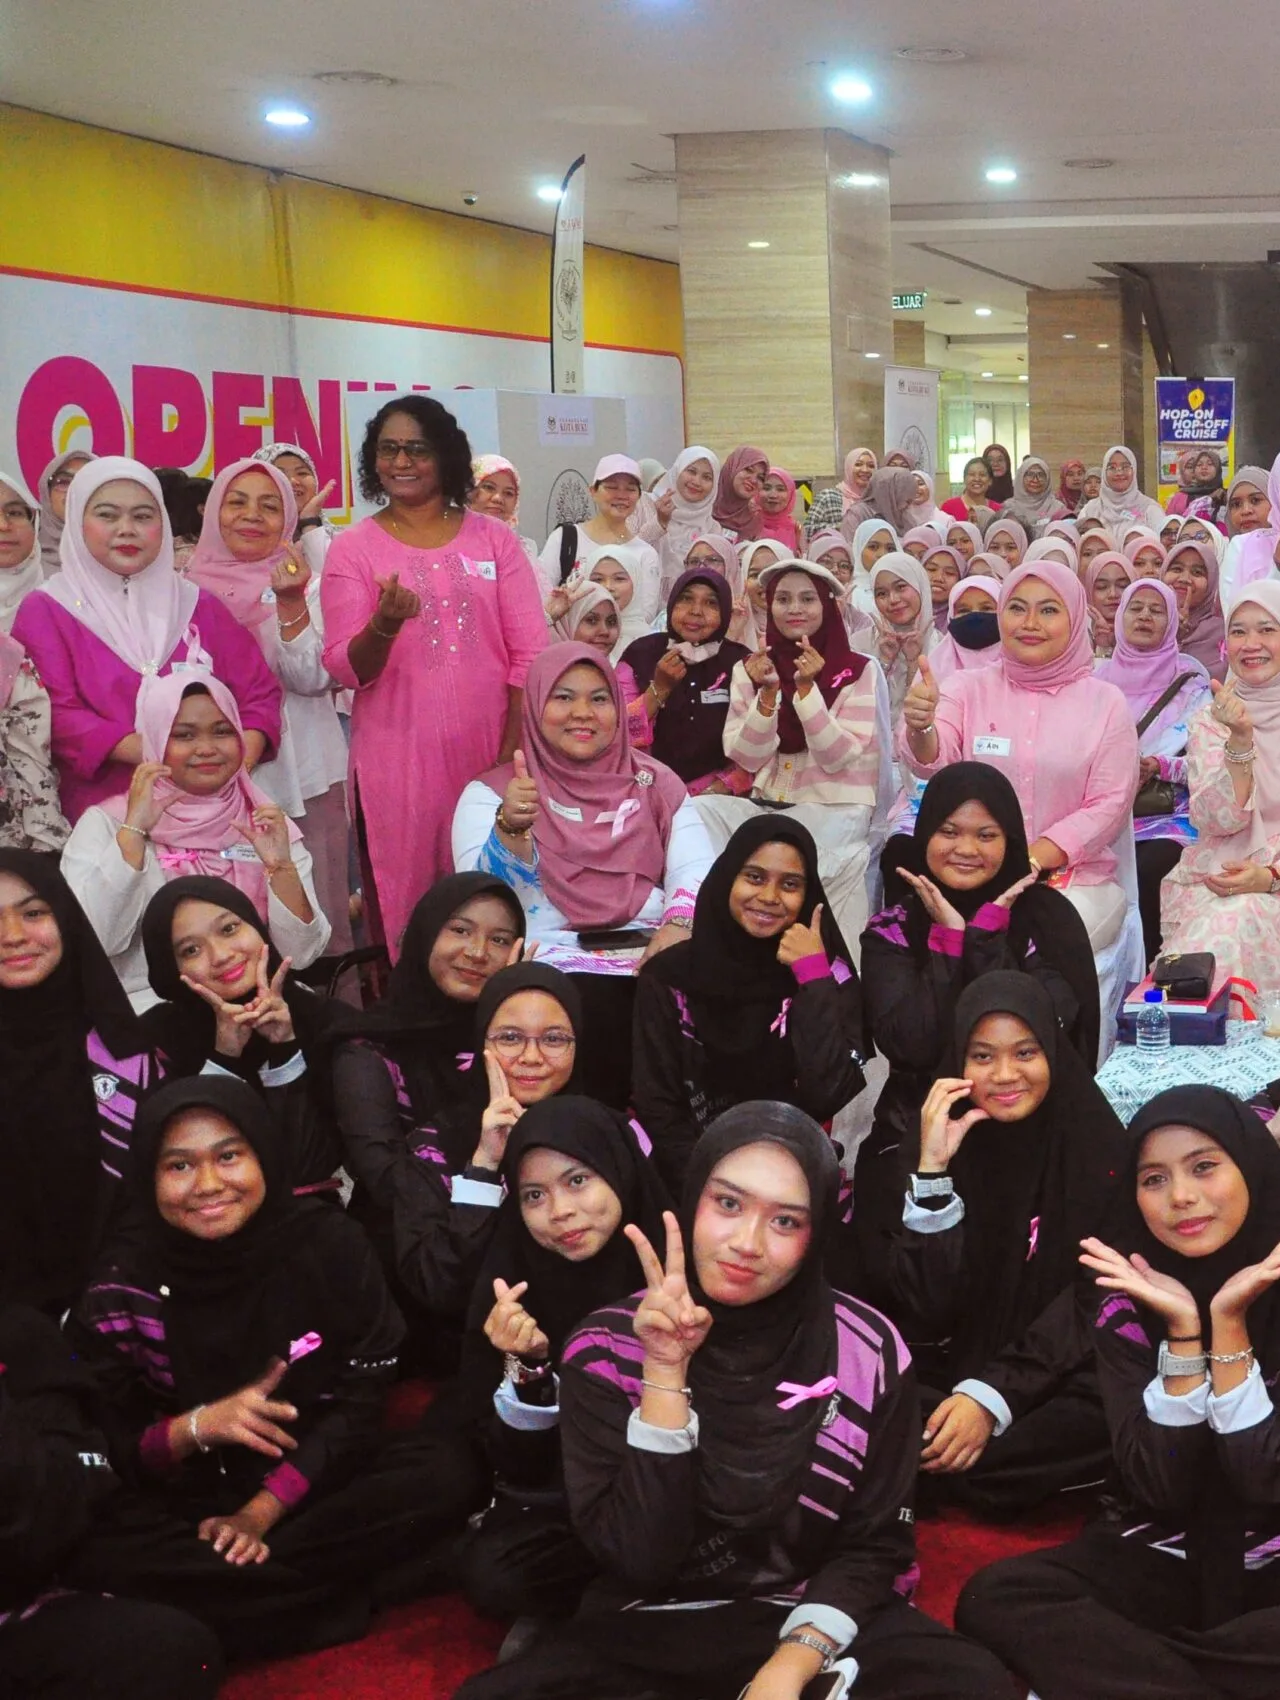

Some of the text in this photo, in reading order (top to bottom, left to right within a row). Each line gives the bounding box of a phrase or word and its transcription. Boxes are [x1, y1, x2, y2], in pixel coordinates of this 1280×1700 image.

[892, 295, 921, 309] ELUAR
[1160, 408, 1215, 420] HOP-ON
[1172, 419, 1230, 430] HOP-OFF
[17, 356, 476, 508] OPEN
[1174, 429, 1219, 439] CRUISE
[78, 1452, 110, 1469] TE
[898, 1506, 914, 1524] TE
